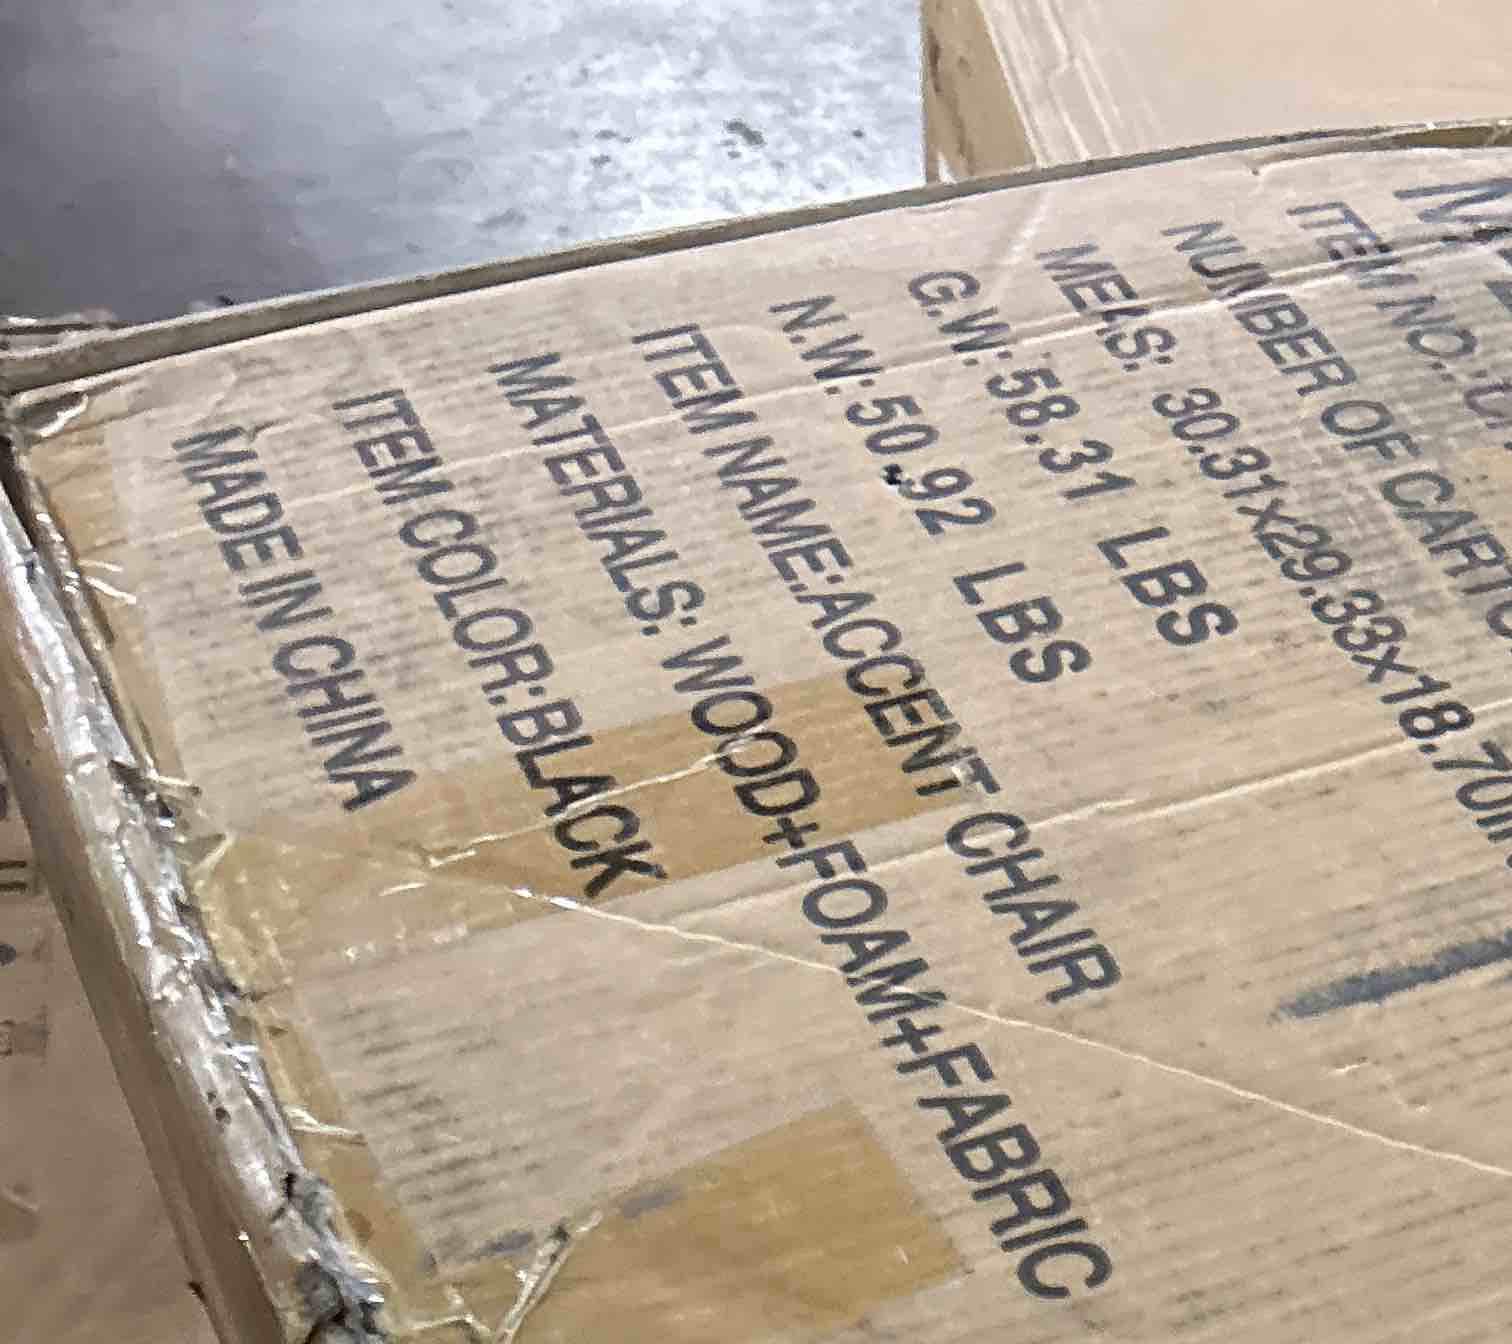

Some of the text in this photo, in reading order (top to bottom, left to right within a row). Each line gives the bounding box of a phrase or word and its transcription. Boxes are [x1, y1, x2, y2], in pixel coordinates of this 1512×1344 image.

[334, 389, 430, 516] ITEM
[1160, 220, 1357, 397] NUMBER
[1320, 399, 1422, 461] OF
[173, 426, 419, 814] MADE IN CHINA
[631, 321, 754, 443] ITEM
[947, 811, 1121, 1003] CHAIR
[953, 562, 1092, 684] LBS
[1097, 527, 1238, 647] LBS
[489, 351, 1112, 1301] MATERIALS: WOOD+FOAM+FABRIC
